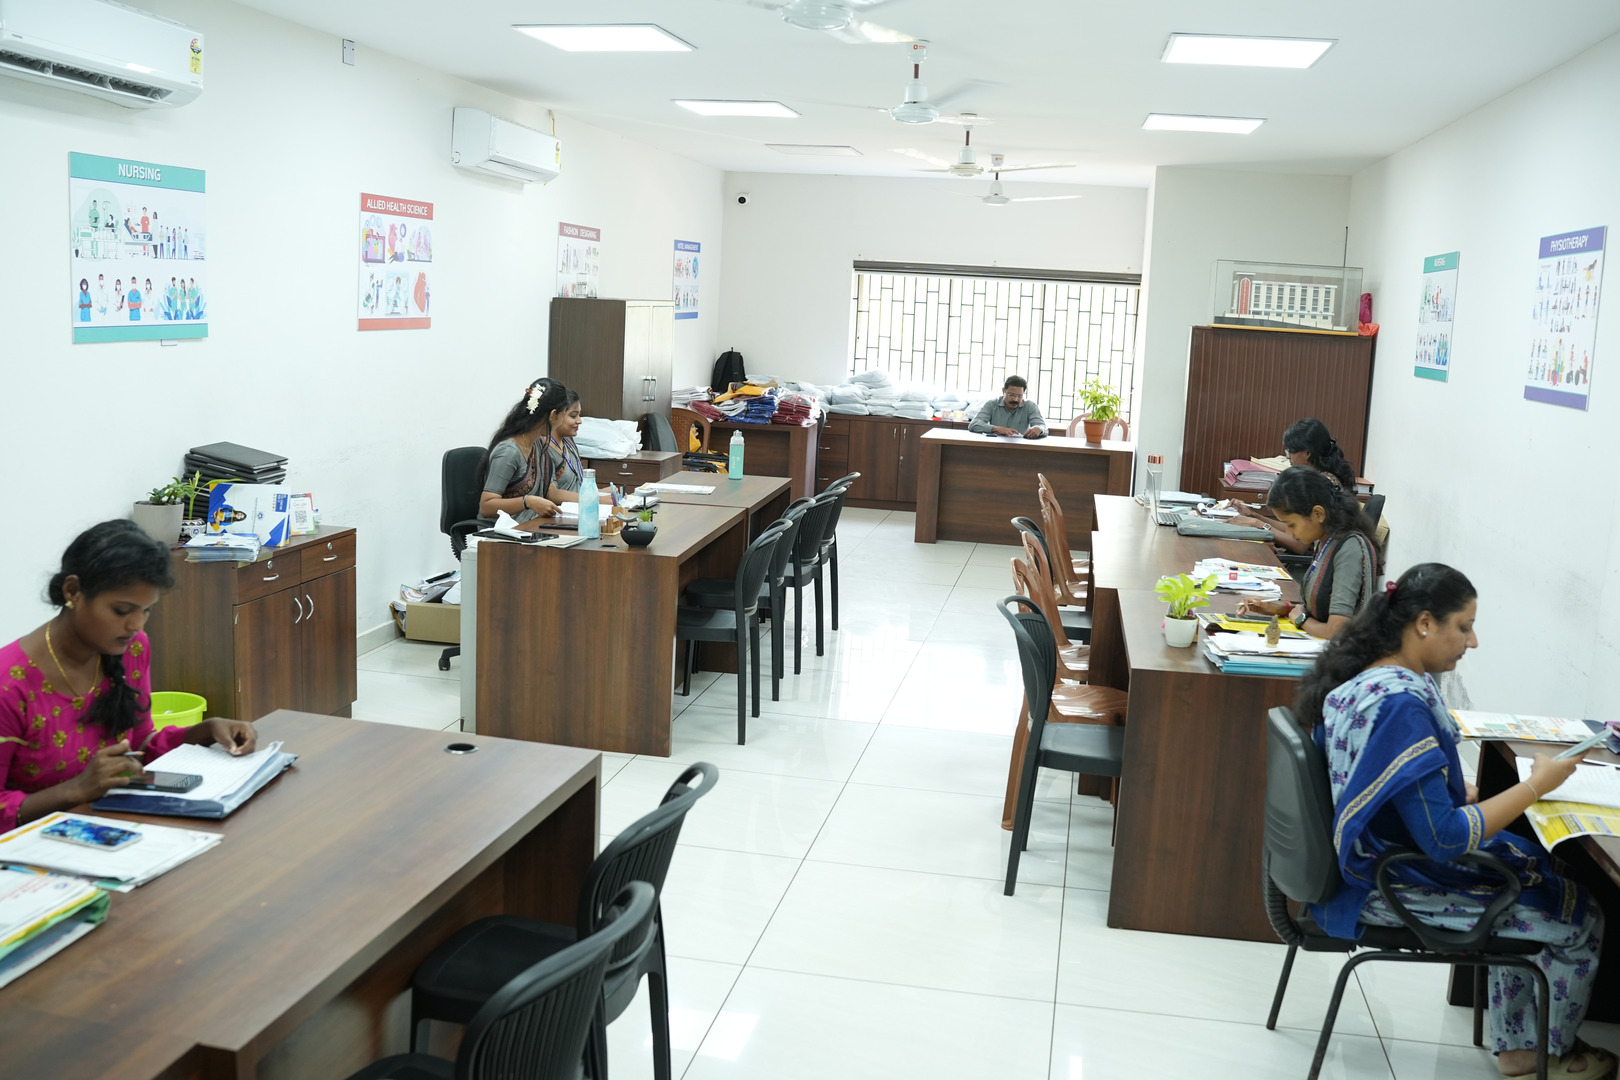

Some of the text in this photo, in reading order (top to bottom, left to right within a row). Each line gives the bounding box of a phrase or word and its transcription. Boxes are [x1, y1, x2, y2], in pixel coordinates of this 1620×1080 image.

[118, 163, 161, 181] NURSING
[366, 198, 428, 216] ALLIED HEALTH SCIENCE
[1550, 235, 1589, 253] PHYSIOTHERAPY
